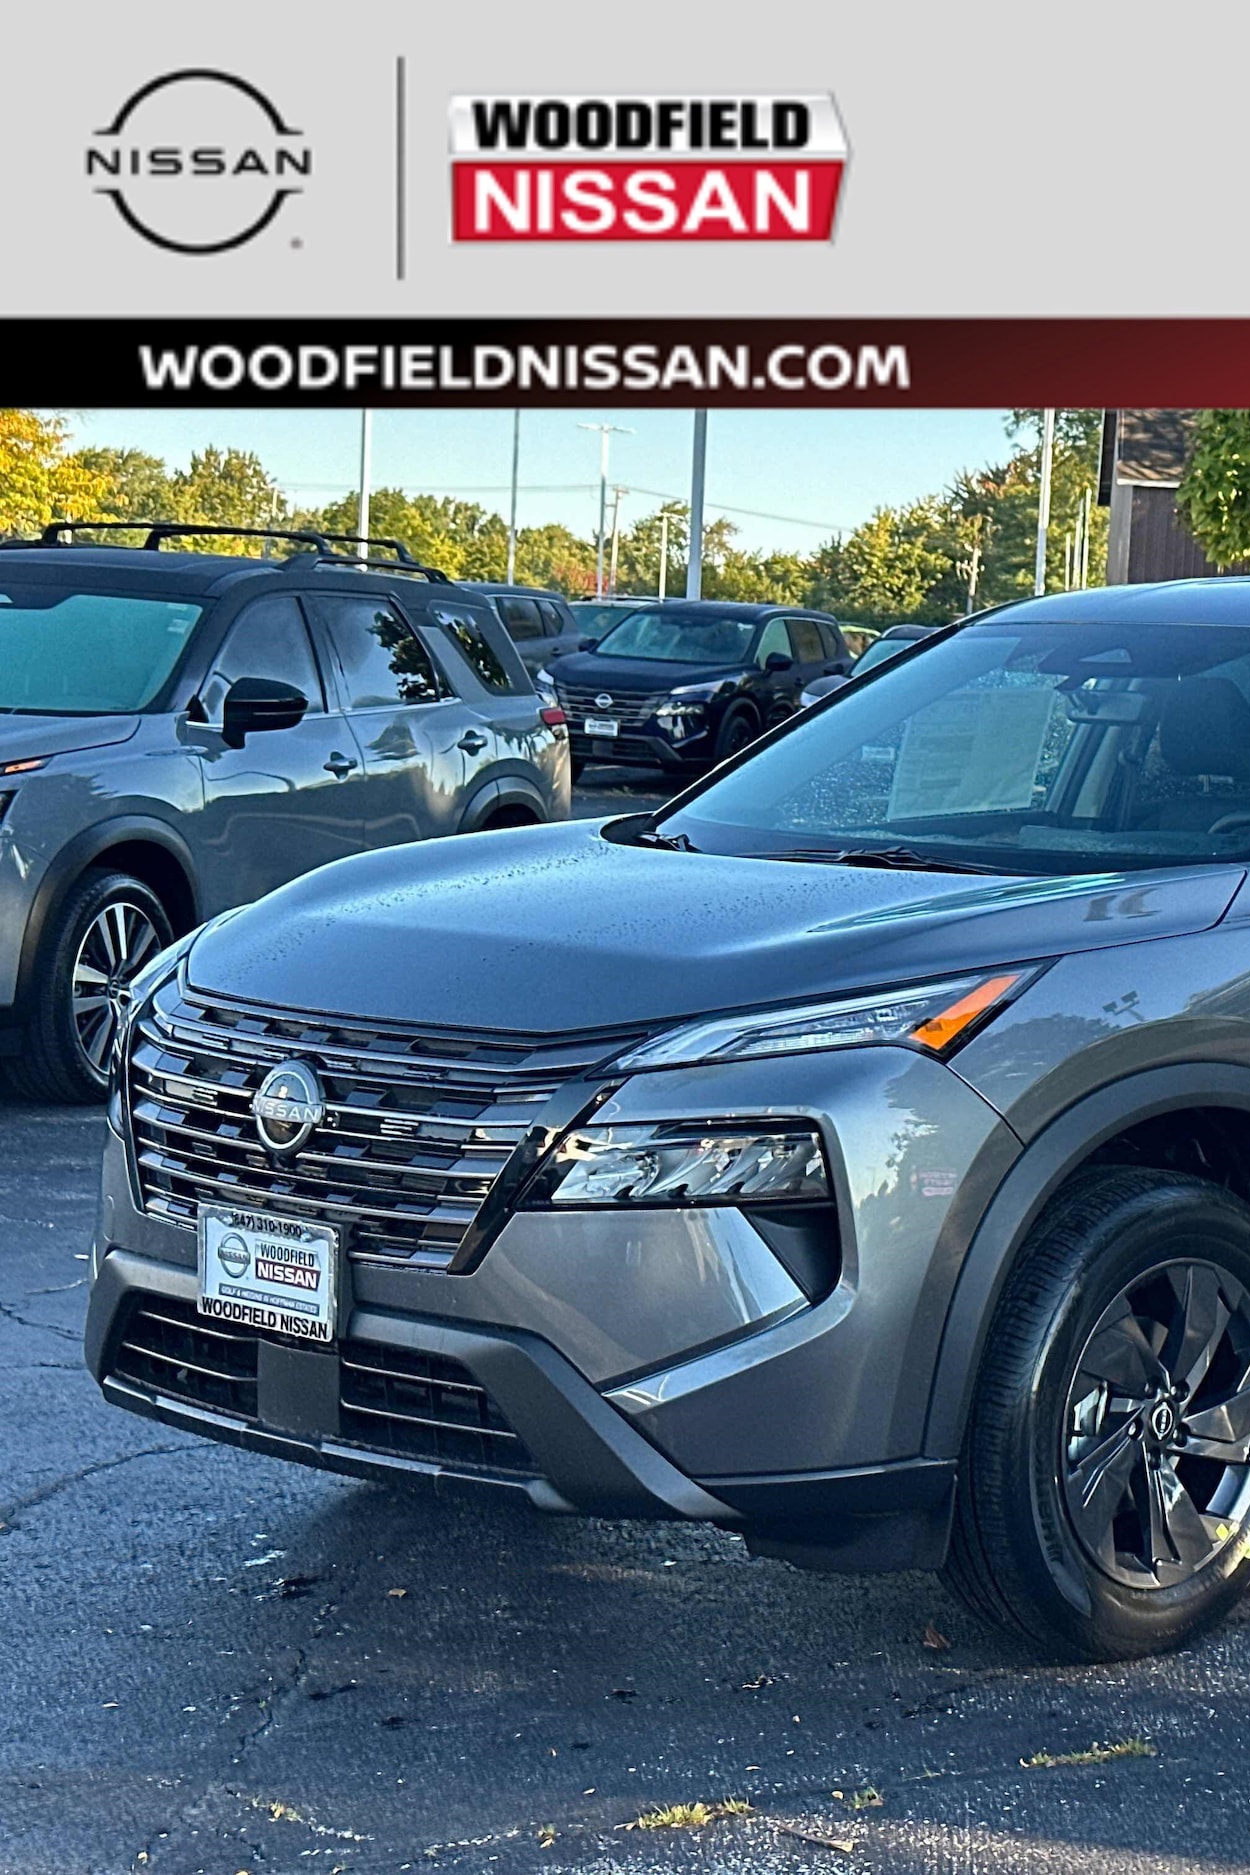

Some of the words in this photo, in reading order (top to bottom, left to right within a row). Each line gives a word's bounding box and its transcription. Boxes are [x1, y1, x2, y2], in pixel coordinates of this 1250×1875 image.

[253, 1098, 319, 1121] NISSAN
[257, 1217, 302, 1238] 310-1900
[260, 1243, 314, 1267] WOODFIELD
[257, 1261, 317, 1289] NISSAN
[201, 1296, 277, 1328] WOODFIELD
[280, 1314, 328, 1340] NISSAN
